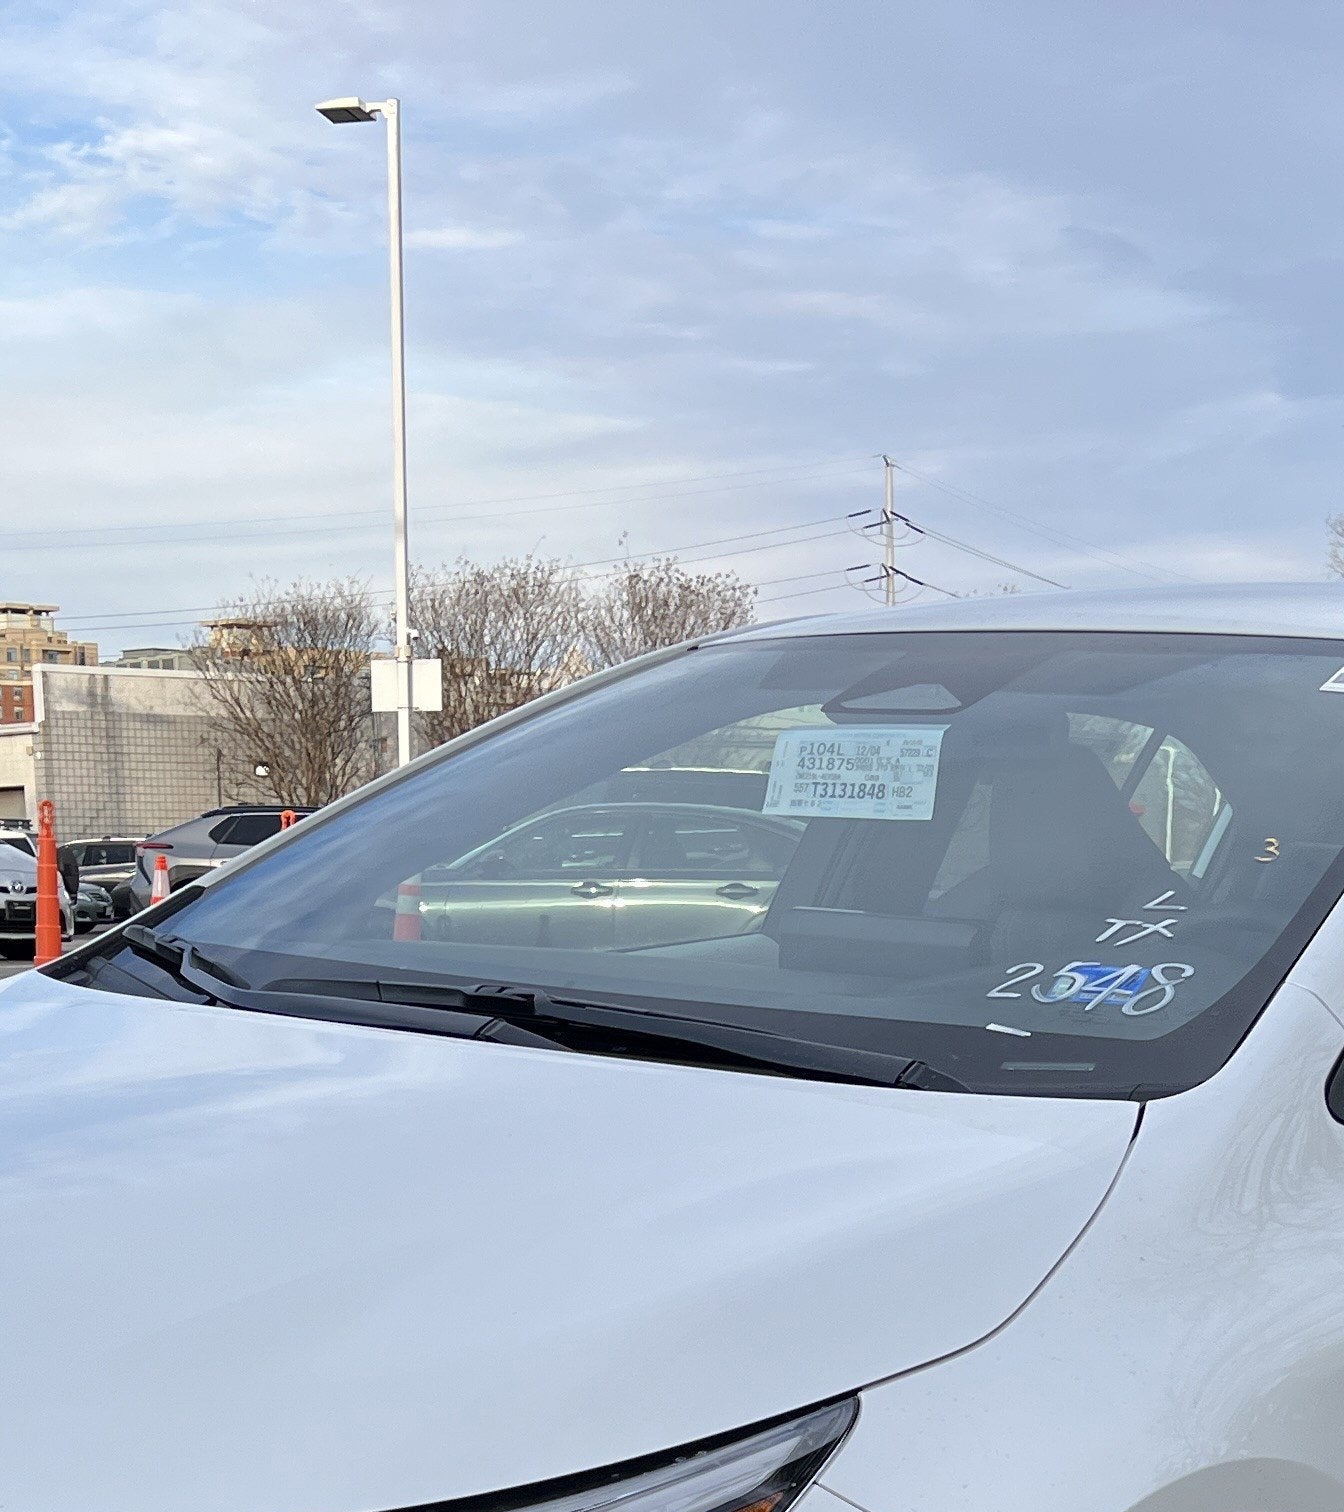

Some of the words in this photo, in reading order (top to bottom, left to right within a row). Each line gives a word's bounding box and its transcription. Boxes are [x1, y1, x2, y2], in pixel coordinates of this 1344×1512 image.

[799, 742, 844, 757] P104L
[797, 757, 855, 772] 431875
[812, 782, 886, 800] T3131848
[1254, 837, 1280, 862] 3
[1095, 918, 1179, 947] TX
[986, 961, 1195, 1017] 2548
